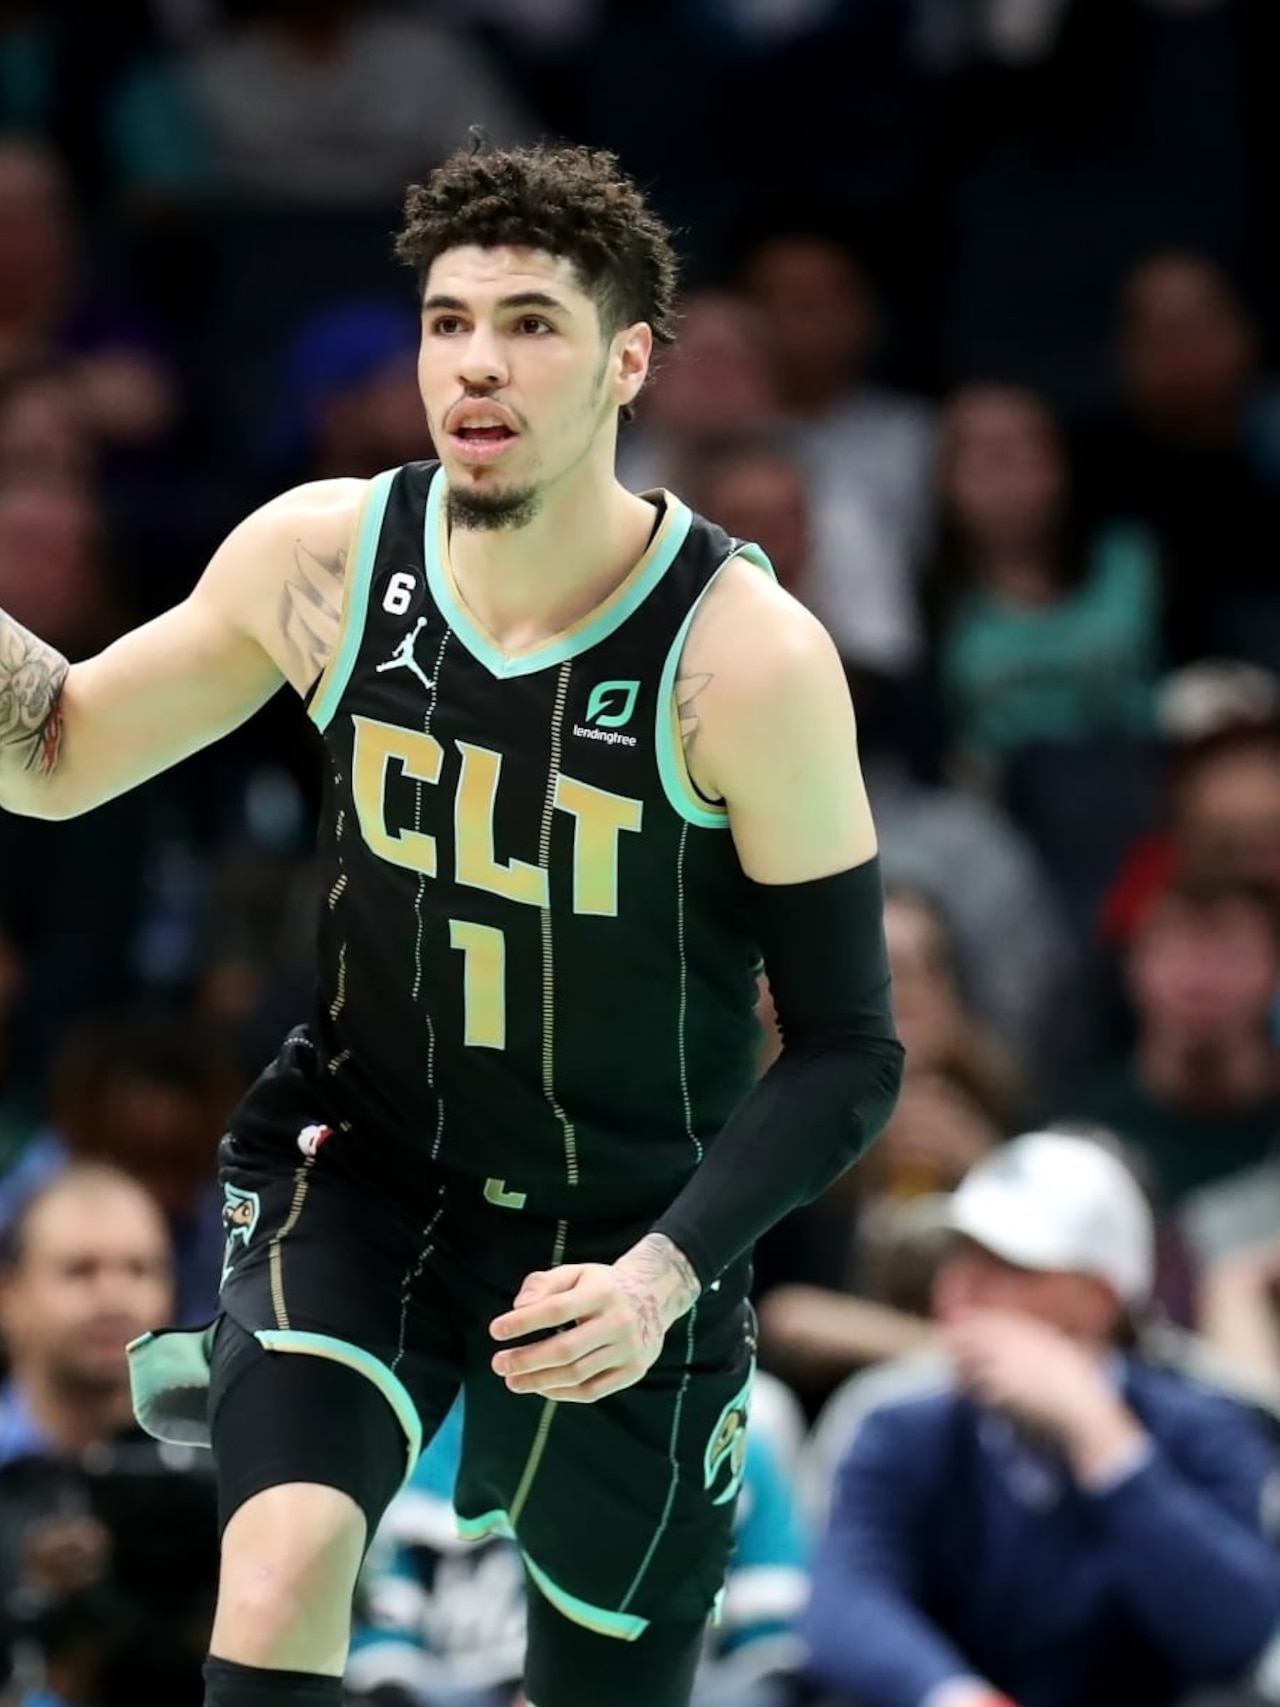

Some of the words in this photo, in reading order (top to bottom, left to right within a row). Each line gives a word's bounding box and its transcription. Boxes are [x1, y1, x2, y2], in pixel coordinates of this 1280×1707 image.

[382, 572, 416, 615] 6
[573, 724, 637, 747] lendingtree
[351, 714, 644, 917] CLT
[449, 918, 506, 1050] 1
